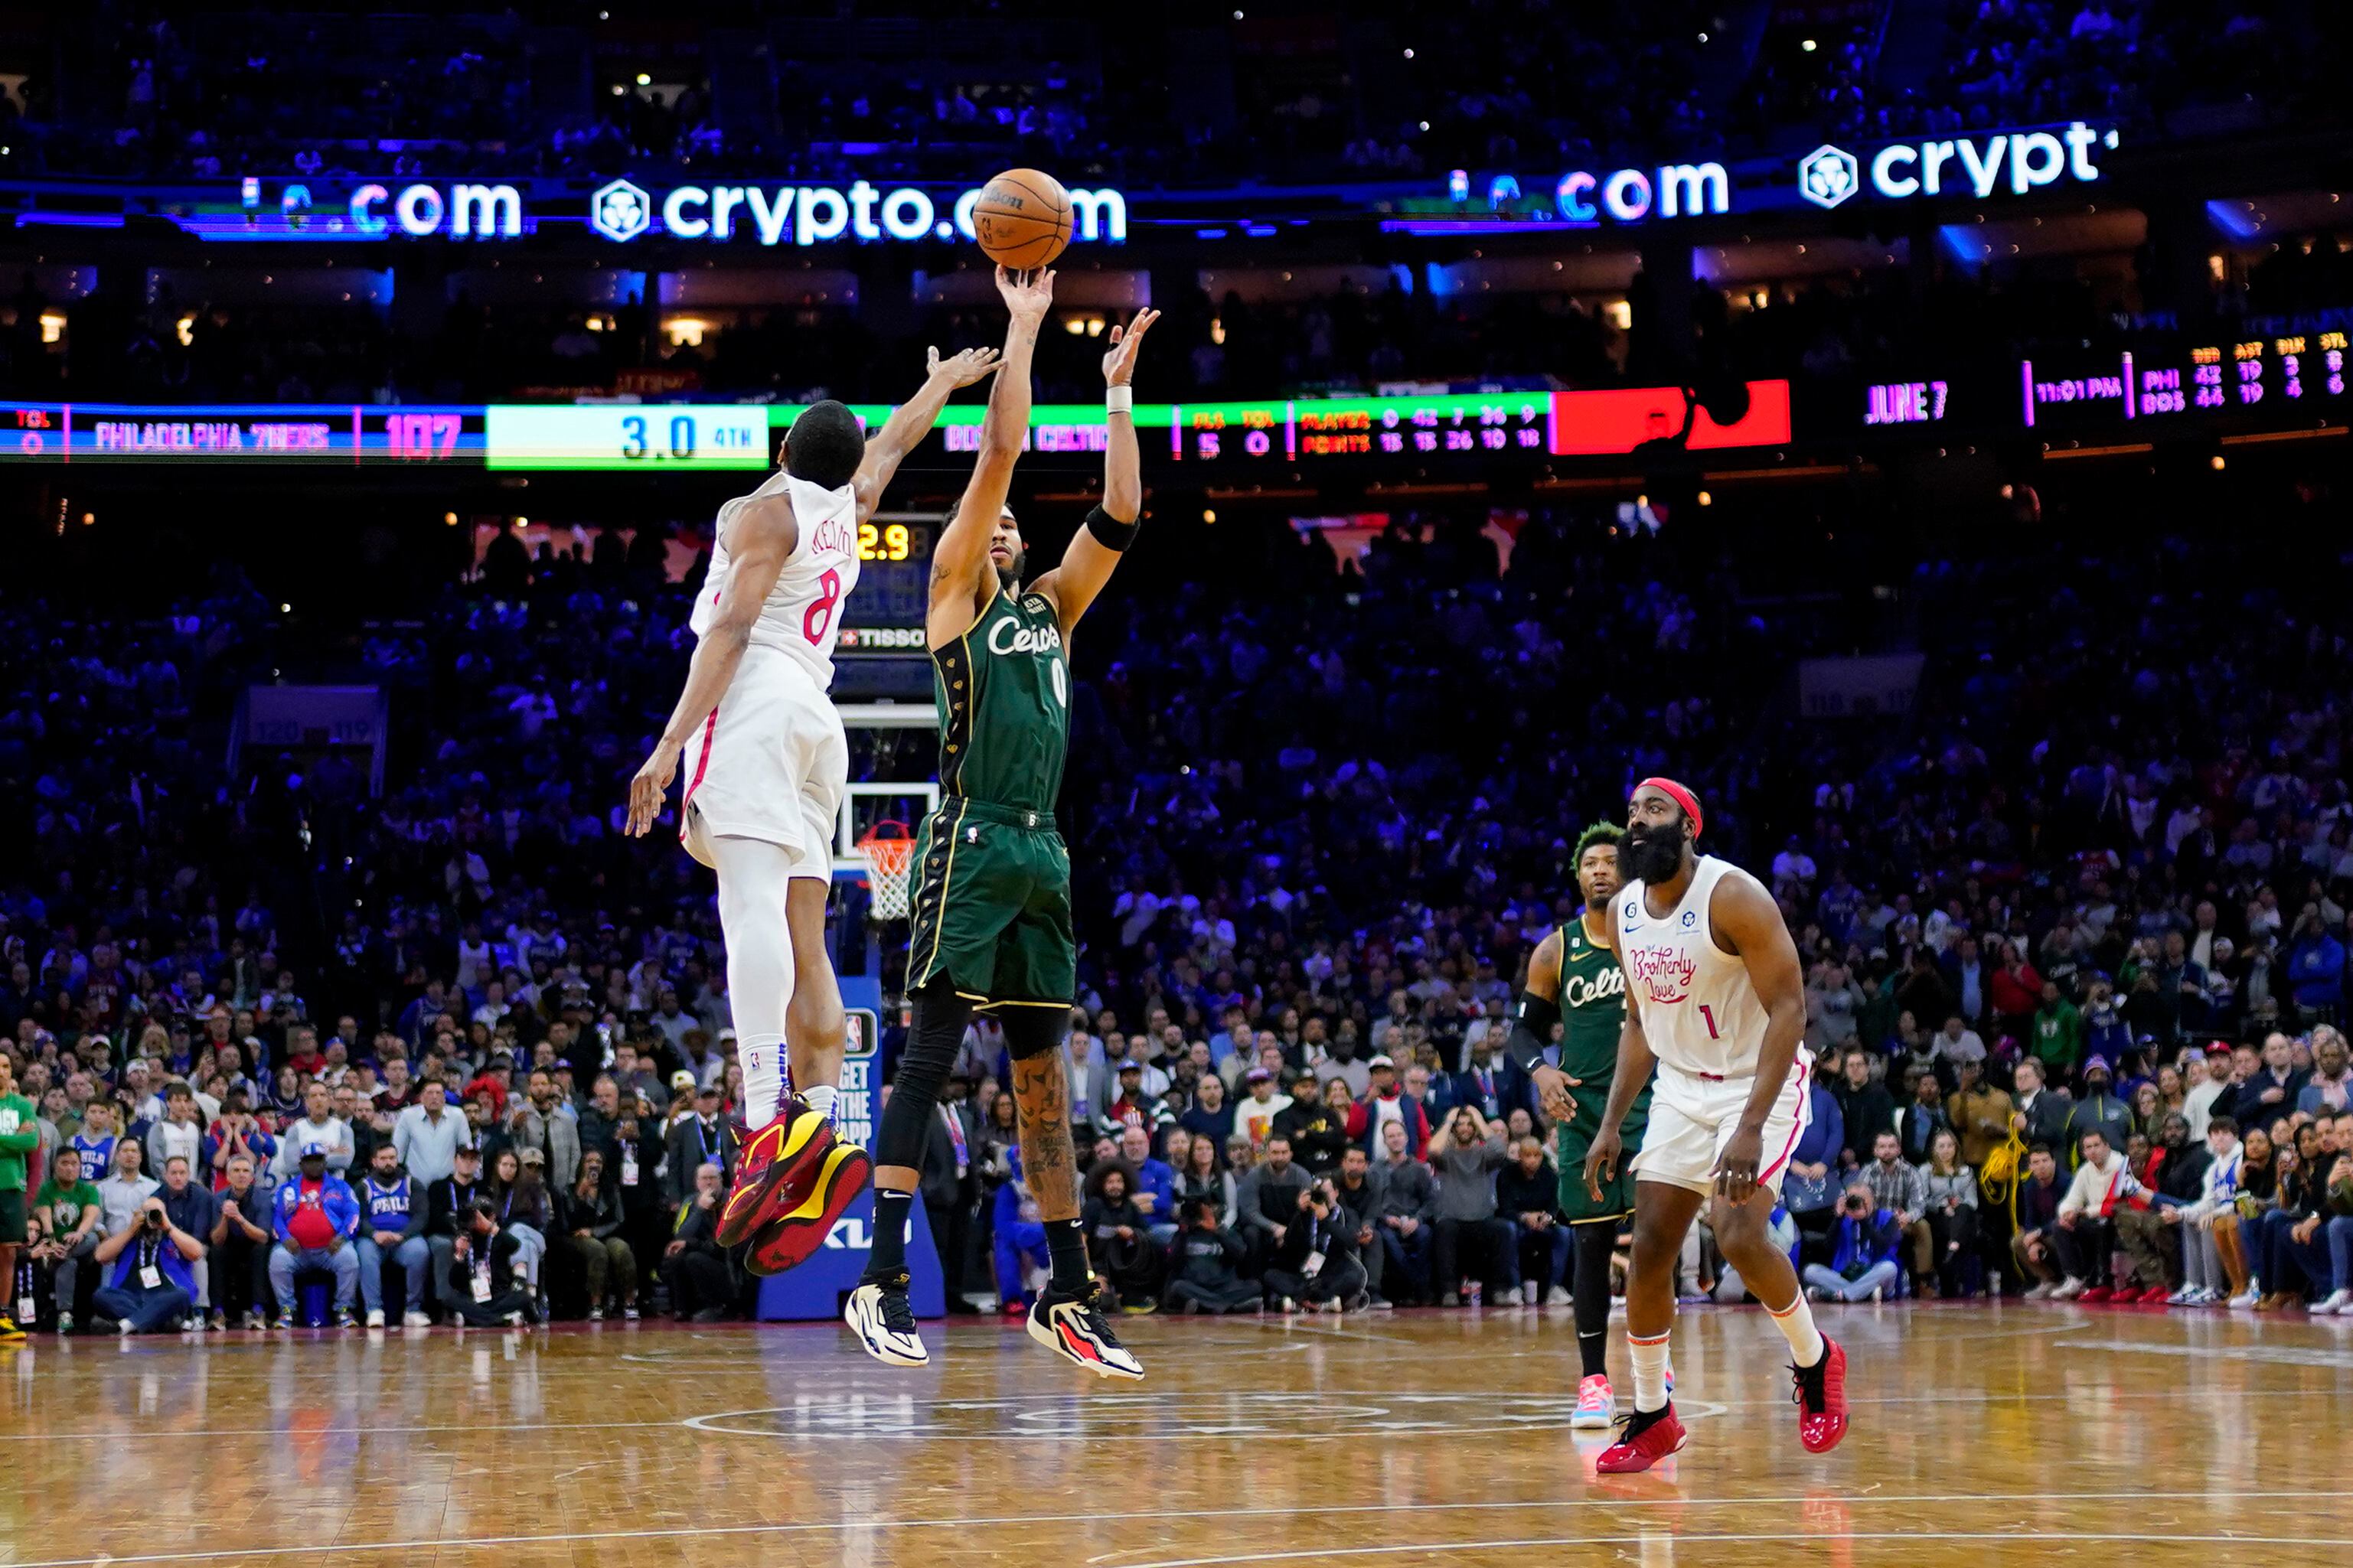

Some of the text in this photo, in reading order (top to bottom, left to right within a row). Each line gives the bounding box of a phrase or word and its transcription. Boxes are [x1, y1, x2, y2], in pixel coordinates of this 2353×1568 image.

[1871, 122, 2119, 198] crypt
[663, 181, 1126, 246] crypto.cm
[1931, 381, 1947, 419] 7
[95, 422, 242, 451] PHILADELPHIA
[386, 415, 461, 459] 107
[622, 416, 751, 460] 3.0 4TH
[857, 524, 909, 561] 2.9
[804, 568, 840, 647] 8
[859, 628, 926, 647] TISSO
[1052, 657, 1067, 709] 0
[1630, 947, 1696, 986] Brotherly
[1699, 1005, 1719, 1039] 1
[839, 1061, 870, 1090] GET
[839, 1091, 871, 1120] THE
